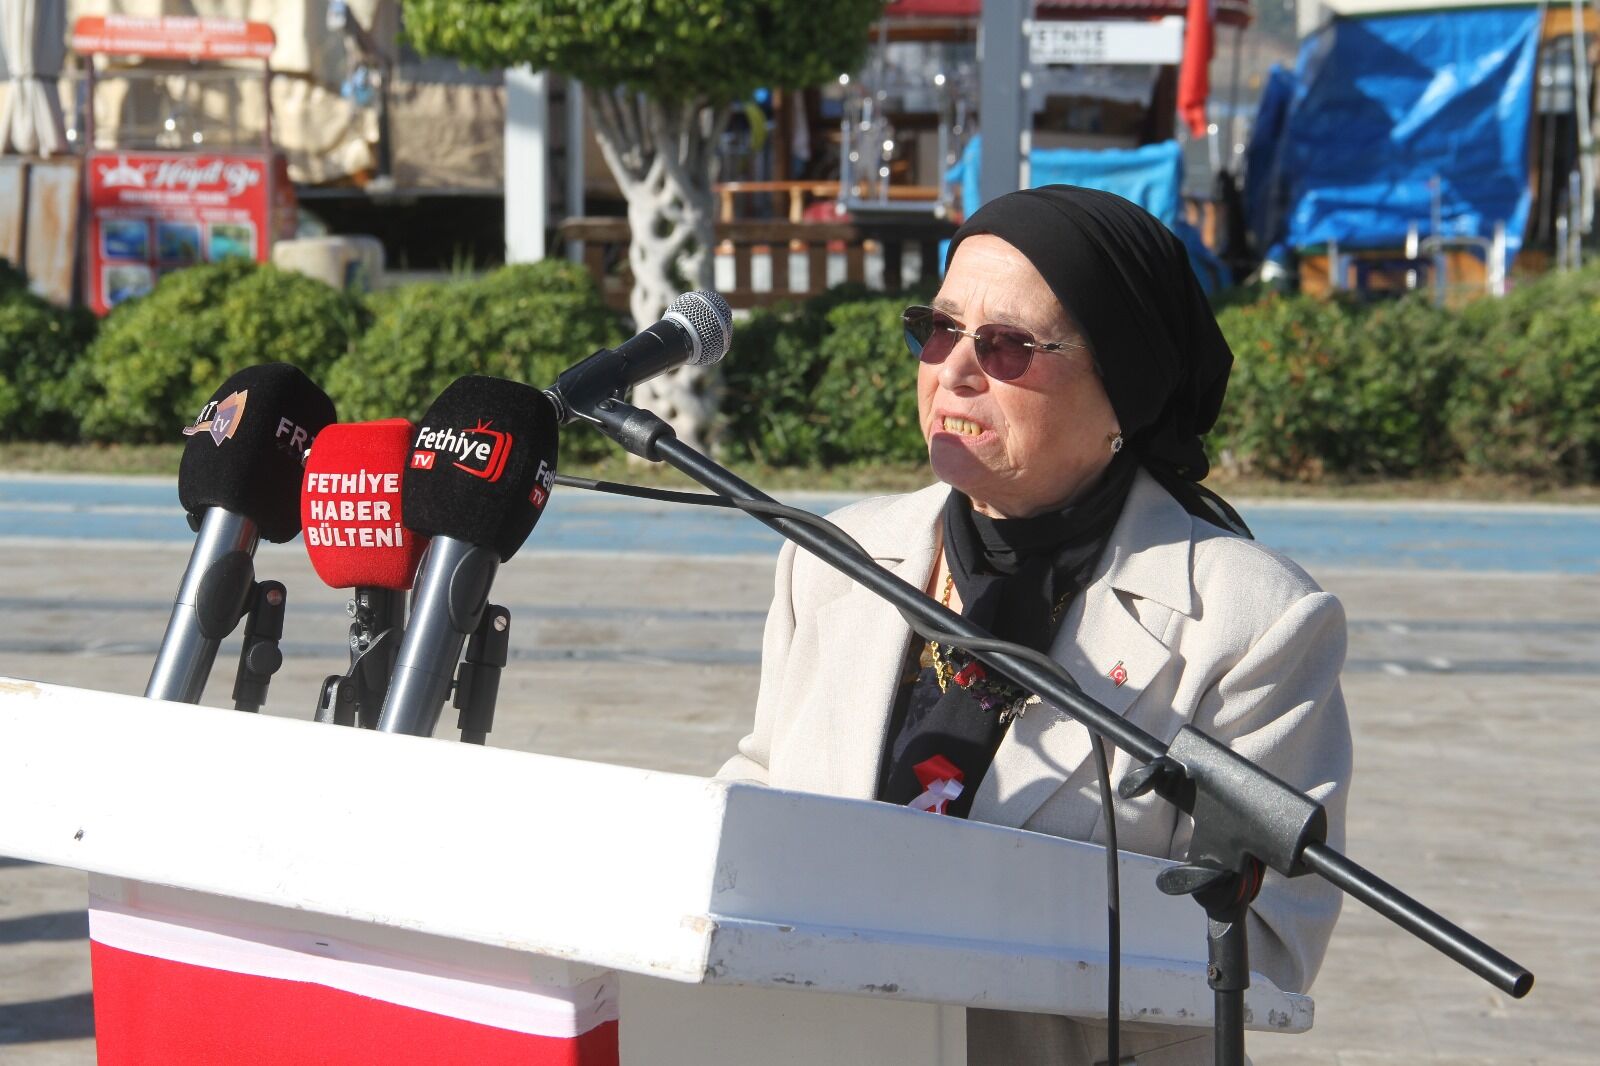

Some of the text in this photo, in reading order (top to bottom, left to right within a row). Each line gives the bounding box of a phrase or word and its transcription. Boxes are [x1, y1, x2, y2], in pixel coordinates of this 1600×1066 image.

[275, 416, 315, 453] FR
[415, 426, 491, 461] Fethiye
[414, 454, 432, 467] TV
[307, 469, 399, 494] FETHİYE
[310, 500, 391, 521] HABER
[307, 522, 403, 547] BÜLTENİ
